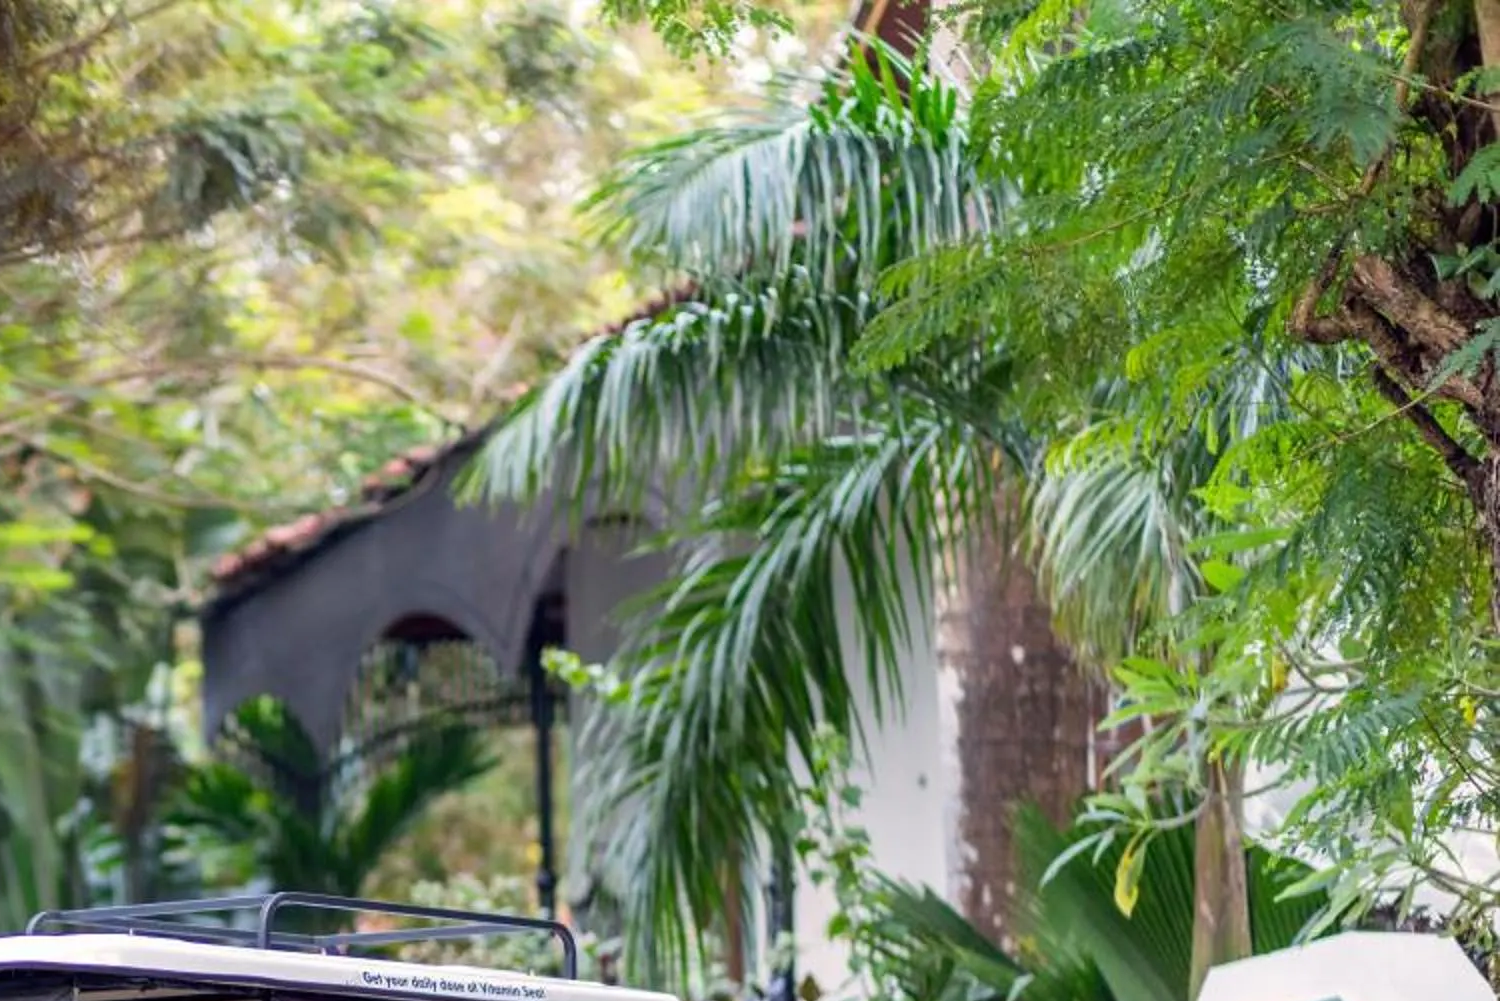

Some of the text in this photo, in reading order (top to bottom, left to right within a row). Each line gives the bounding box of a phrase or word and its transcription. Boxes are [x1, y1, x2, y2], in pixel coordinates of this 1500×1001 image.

[362, 971, 383, 985] Get
[385, 975, 408, 989] your
[411, 975, 437, 993] daily
[439, 977, 465, 992] dose
[479, 982, 521, 997] Vitamin
